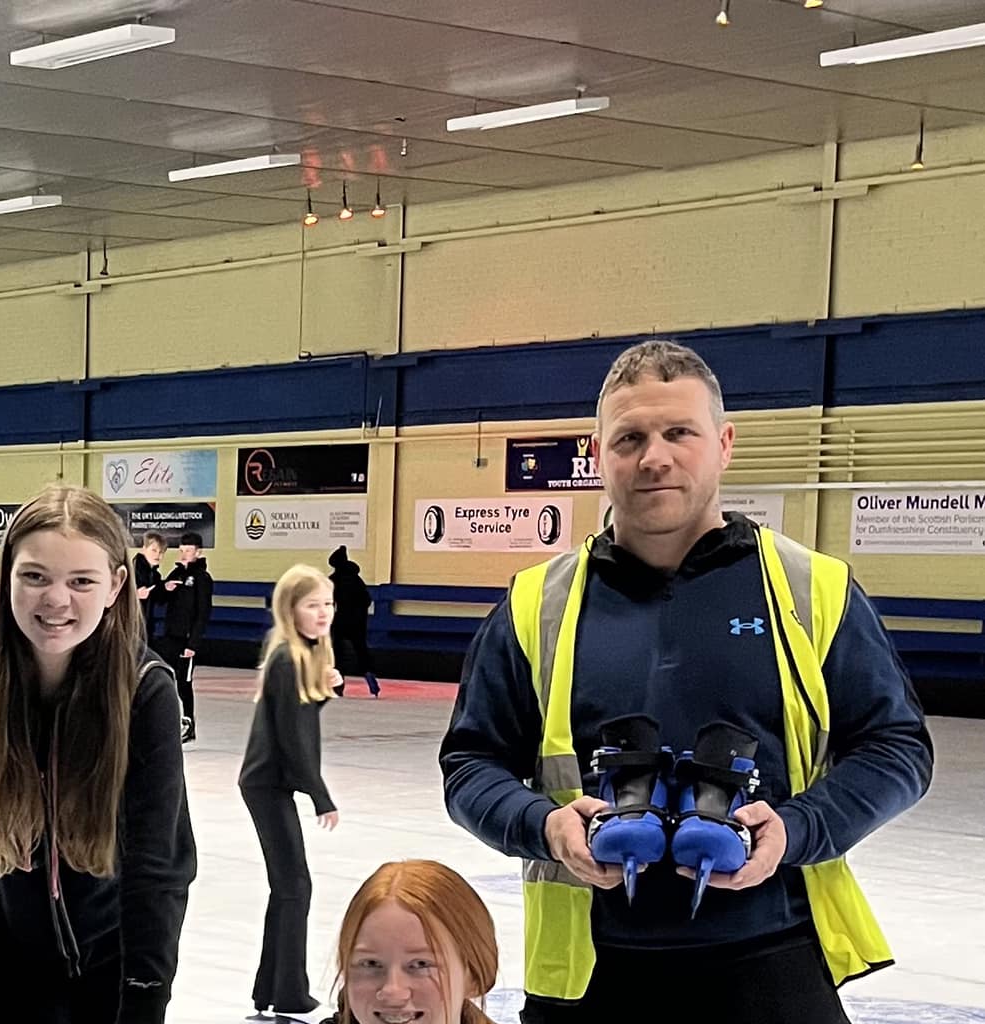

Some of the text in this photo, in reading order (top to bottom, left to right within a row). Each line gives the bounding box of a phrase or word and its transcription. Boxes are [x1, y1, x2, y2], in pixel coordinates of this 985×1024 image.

[134, 458, 174, 485] Elite
[547, 480, 571, 488] YOUTH
[857, 495, 902, 510] Oliver
[906, 495, 970, 510] Mundell
[270, 512, 299, 520] SOLWAY
[455, 506, 530, 521] Express Tyre
[857, 515, 890, 524] Member
[893, 515, 901, 523] of
[903, 515, 915, 523] the
[918, 514, 952, 523] Scottish
[271, 521, 320, 530] AGRICULTURE
[470, 522, 512, 533] Service
[856, 525, 866, 534] for
[927, 525, 984, 536] Constituency
